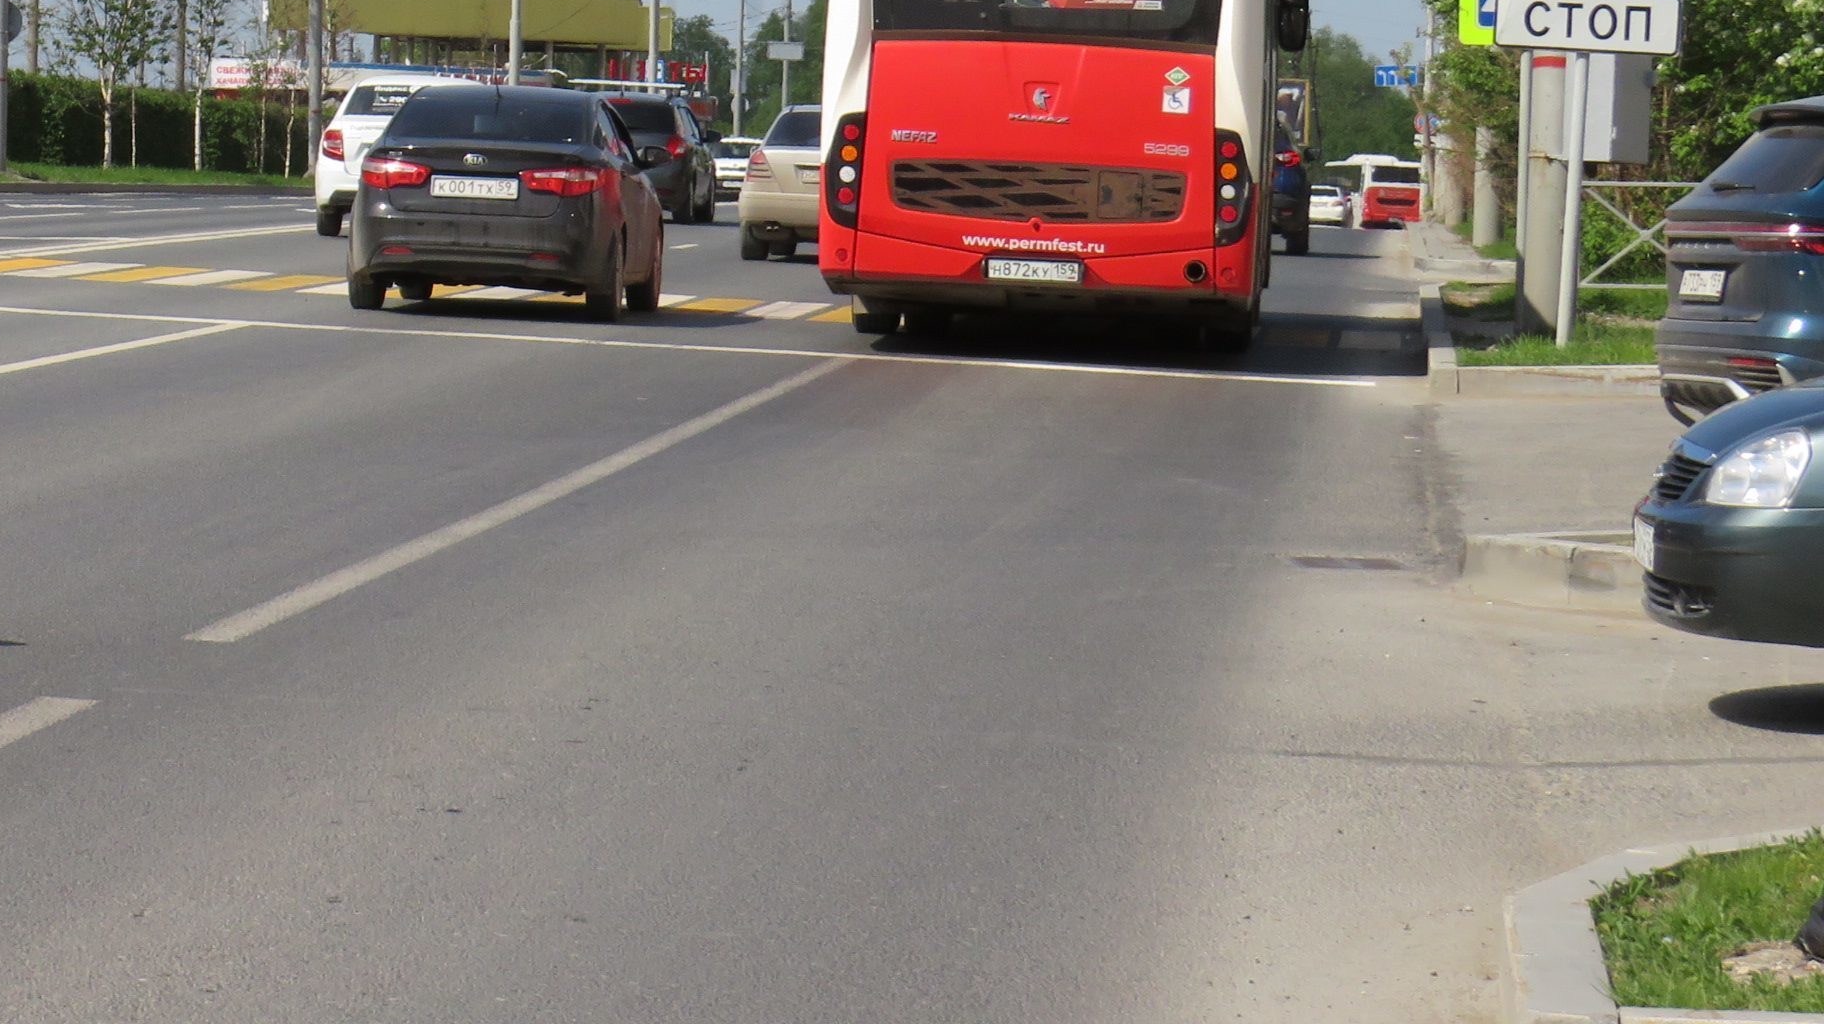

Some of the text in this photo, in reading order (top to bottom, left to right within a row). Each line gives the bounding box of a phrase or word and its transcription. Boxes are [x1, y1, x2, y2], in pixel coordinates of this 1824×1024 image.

[1524, 0, 1652, 42] СТОП
[891, 129, 937, 144] NEFAZ
[496, 180, 513, 192] 59
[962, 235, 1106, 254] www.permfest.ru
[1054, 263, 1076, 276] 159
